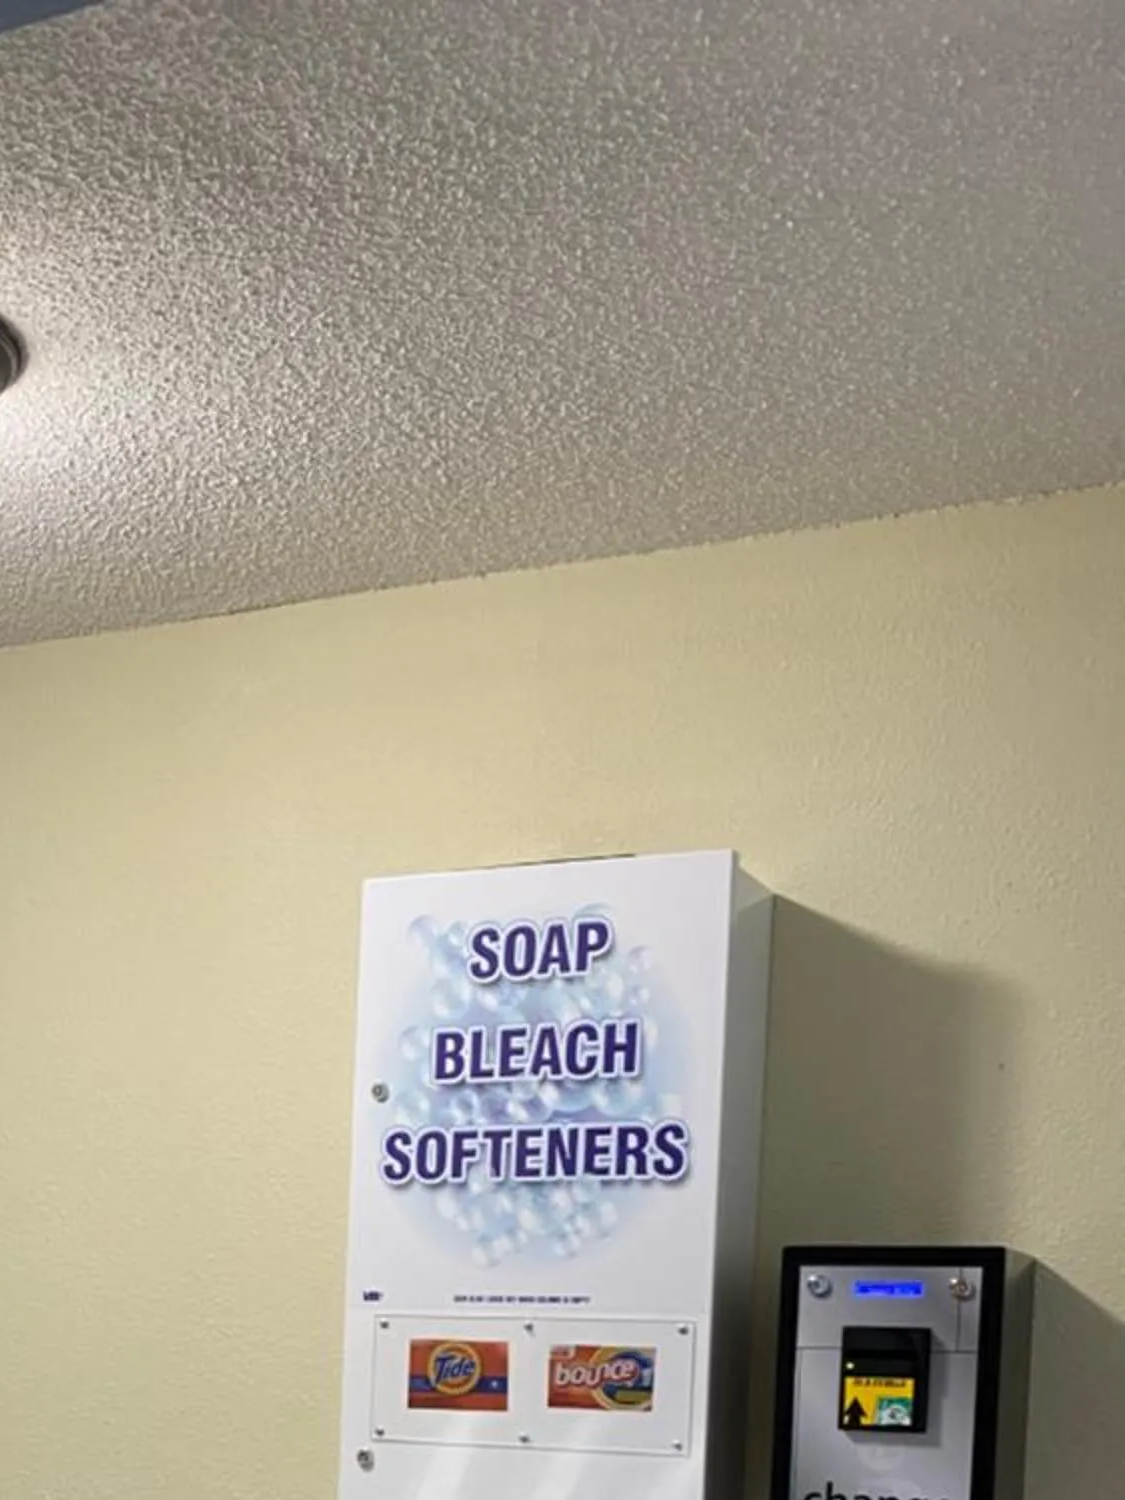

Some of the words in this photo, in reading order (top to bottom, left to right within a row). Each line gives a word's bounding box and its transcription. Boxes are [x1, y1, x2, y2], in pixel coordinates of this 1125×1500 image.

[469, 921, 611, 980] SOAP
[434, 1022, 638, 1080] BLEACH
[383, 1124, 688, 1181] SOFTENERS
[433, 1352, 476, 1384] Tide
[555, 1359, 638, 1386] bounce
